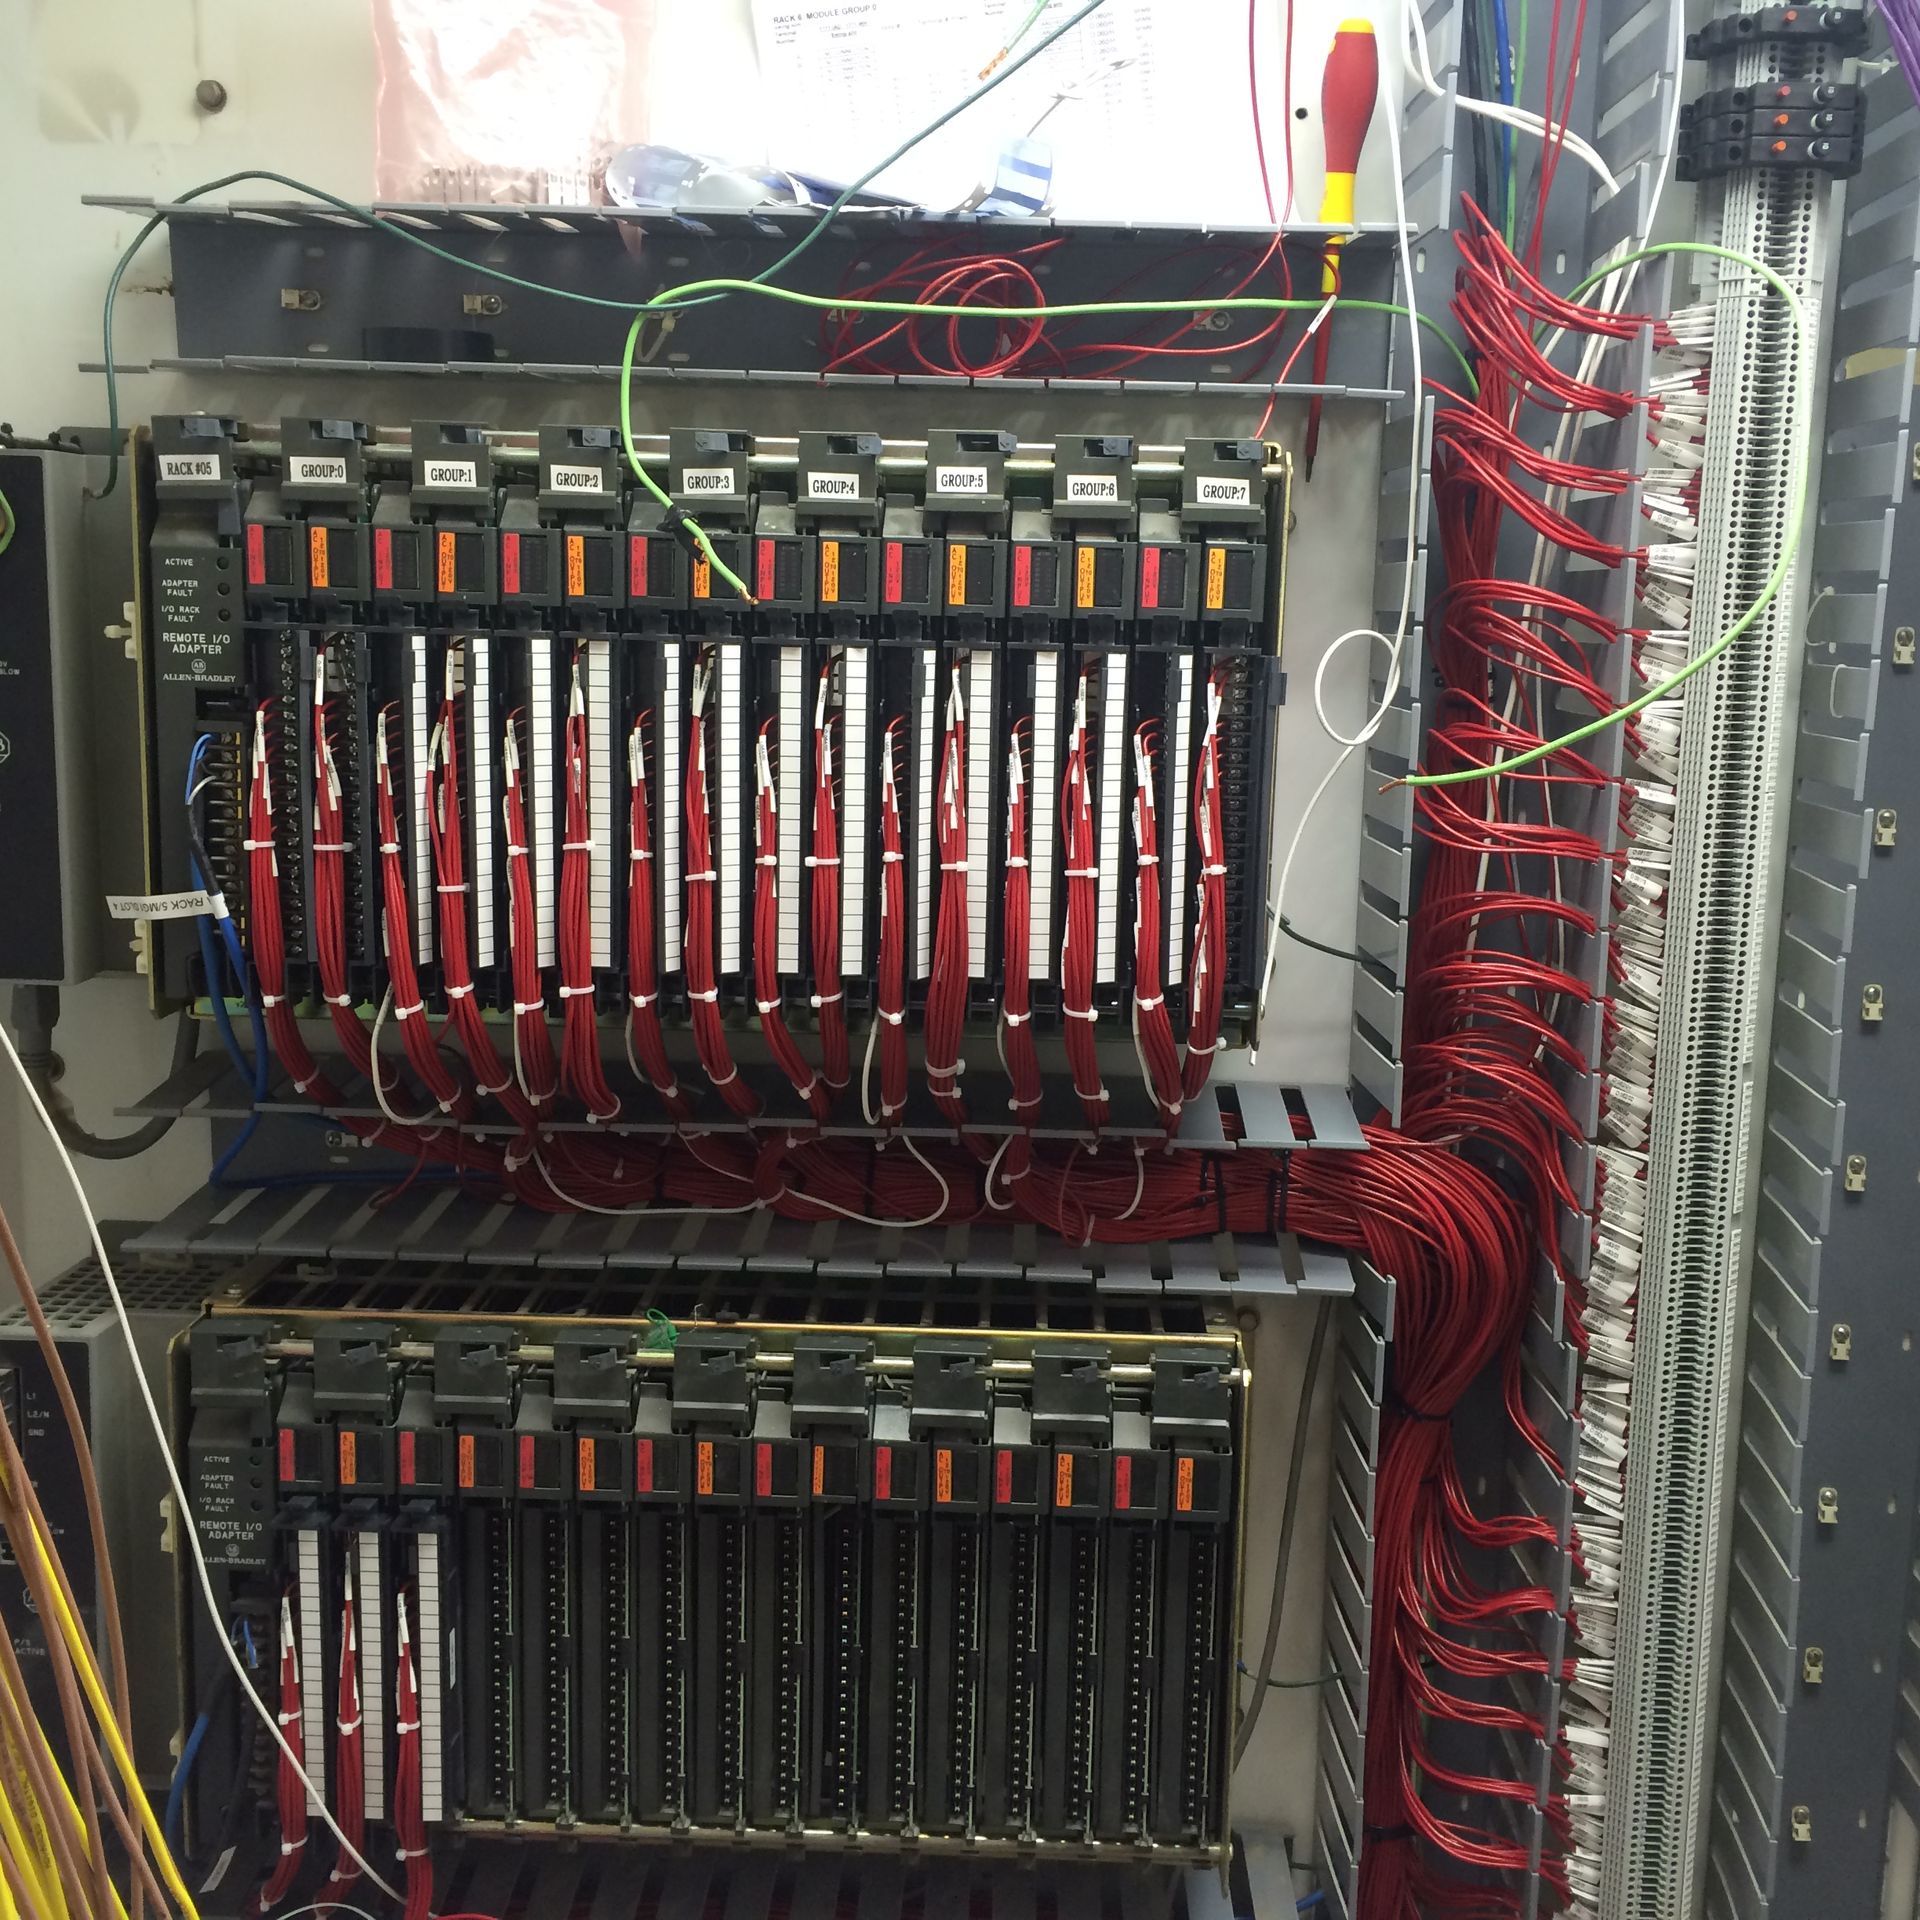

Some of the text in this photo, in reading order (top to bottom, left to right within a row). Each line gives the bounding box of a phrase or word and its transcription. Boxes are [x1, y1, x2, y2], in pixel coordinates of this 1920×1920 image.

[806, 9, 839, 19] MODULE
[841, 5, 870, 15] GROUP
[167, 461, 212, 476] RACK #05
[300, 463, 344, 479] GROUP:0
[430, 467, 473, 483] GROUP:1
[556, 472, 599, 488] GROUP:2
[687, 474, 730, 490] GROUP:3
[940, 473, 984, 489] GROUP:5
[812, 479, 856, 495] GROUP:4
[1071, 482, 1115, 497] GROUP:6
[1203, 485, 1246, 500] GROUP:7
[165, 558, 194, 566] ACTIVE
[161, 579, 198, 588] ADAPTER
[167, 588, 194, 597] FAULT
[161, 605, 200, 614] I/O RACK
[167, 614, 194, 623] FAULT
[162, 633, 231, 644] REMOTE I/O
[172, 644, 222, 654] ADAPTER
[163, 673, 236, 683] ALLEN-BRADLEY
[170, 897, 203, 910] RACK
[200, 1474, 234, 1482] ADAPTER
[204, 1482, 229, 1490] FAULT
[214, 1497, 235, 1505] RACK
[200, 1520, 263, 1531] REMOTE I/O
[208, 1531, 255, 1540] ADAPTER
